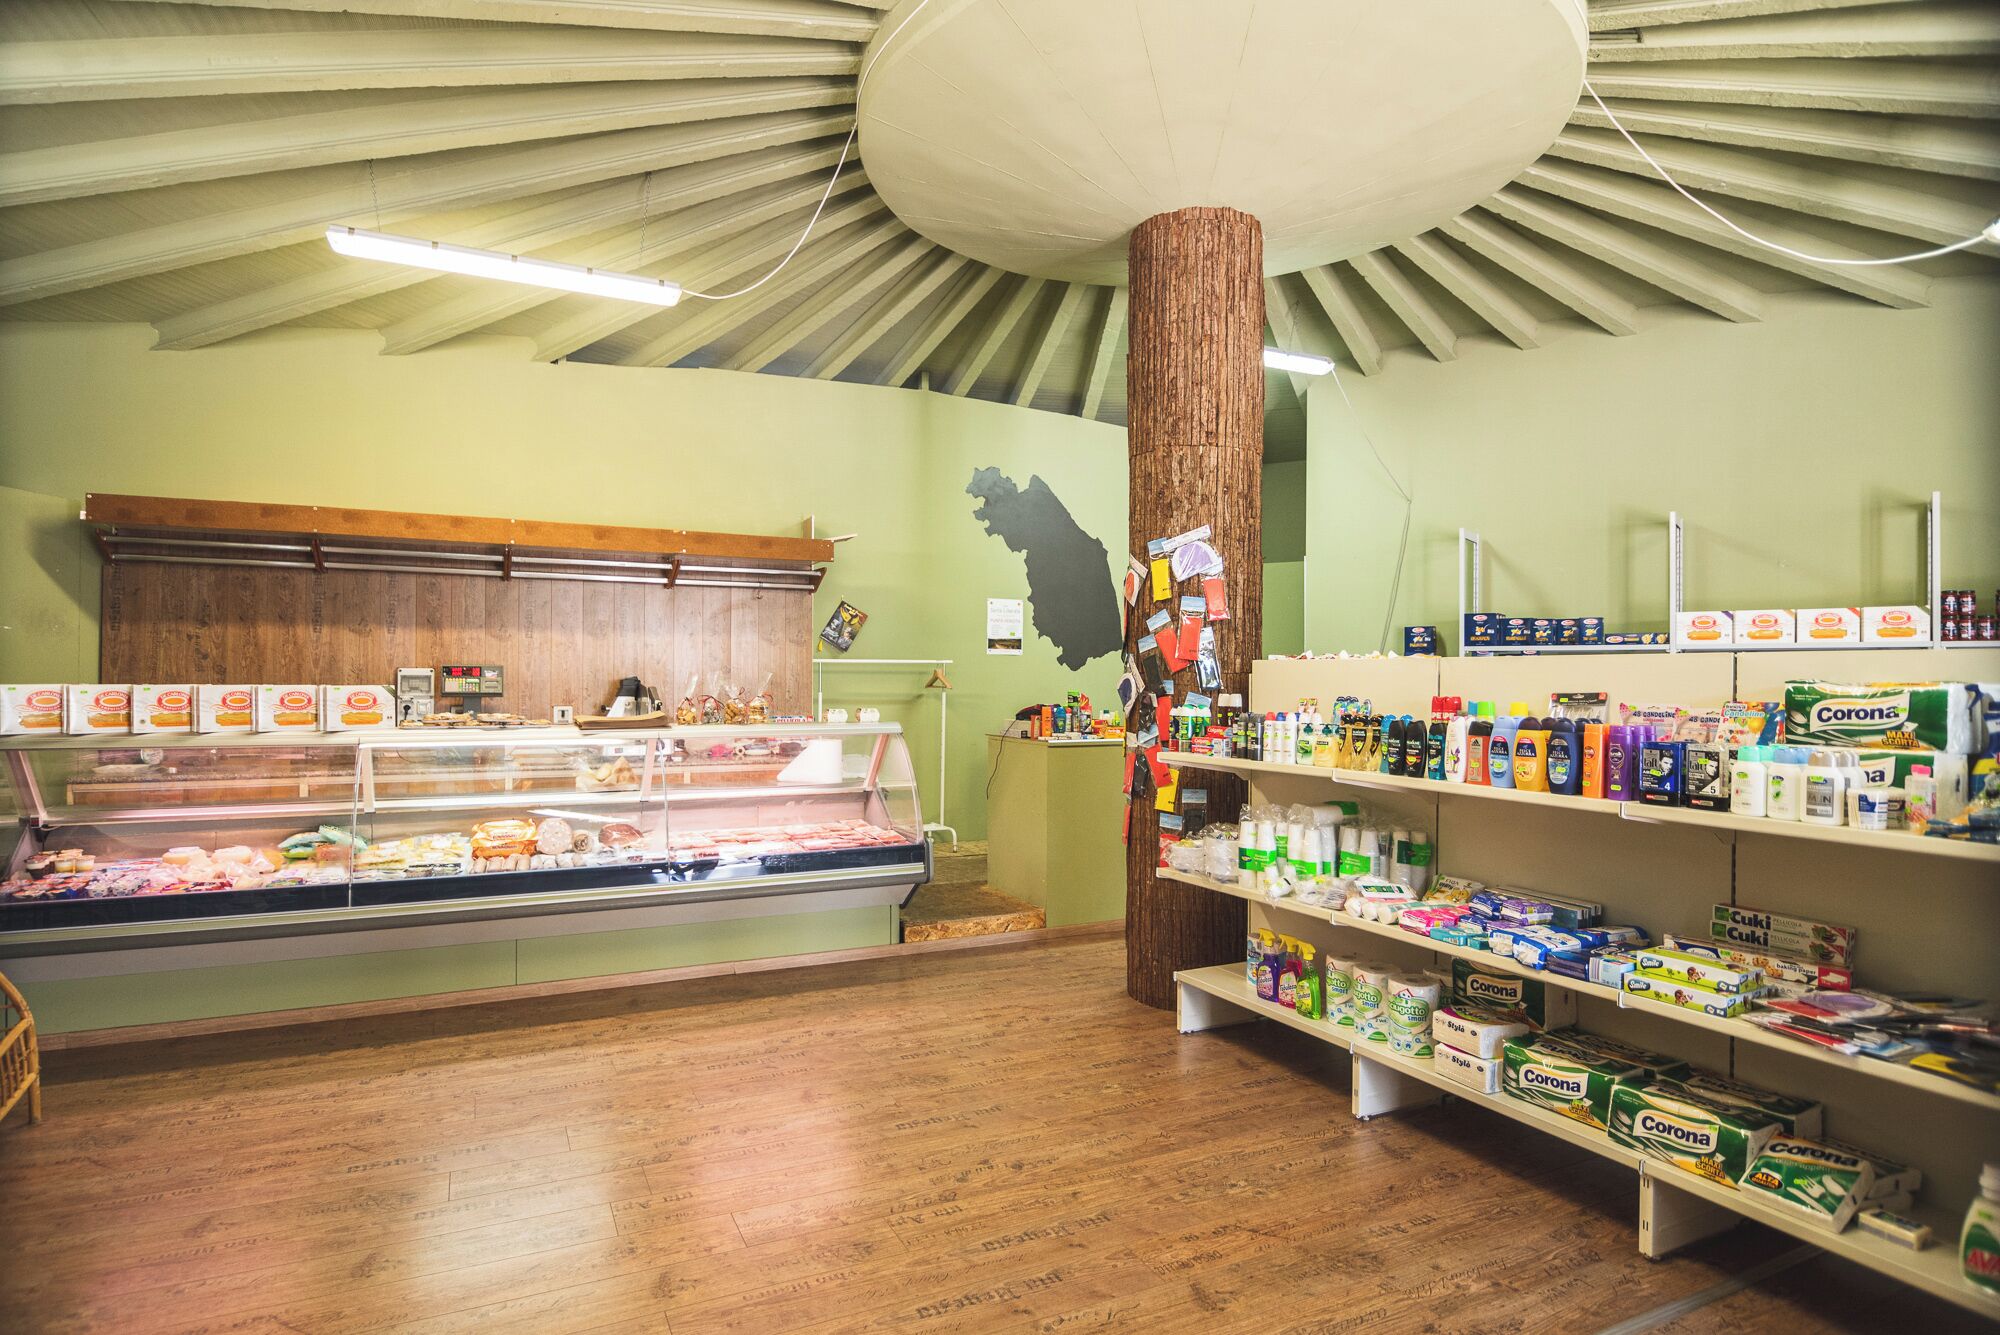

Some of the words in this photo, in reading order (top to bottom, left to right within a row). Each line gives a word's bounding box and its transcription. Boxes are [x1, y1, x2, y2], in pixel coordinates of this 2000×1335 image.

[1817, 705, 1899, 723] Corona
[1664, 782, 1670, 791] 4
[1710, 786, 1716, 794] 5
[1729, 910, 1771, 931] Cuki
[1727, 926, 1769, 947] Cuki
[1642, 958, 1660, 968] Smile
[1776, 963, 1797, 973] baking
[1798, 968, 1817, 976] paper
[1470, 978, 1517, 998] Corona
[1629, 979, 1647, 990] Smile
[1524, 1069, 1581, 1093] Corona
[1641, 1115, 1711, 1147] Corona
[1769, 1142, 1859, 1167] Corona
[1754, 1172, 1779, 1187] ALTA
